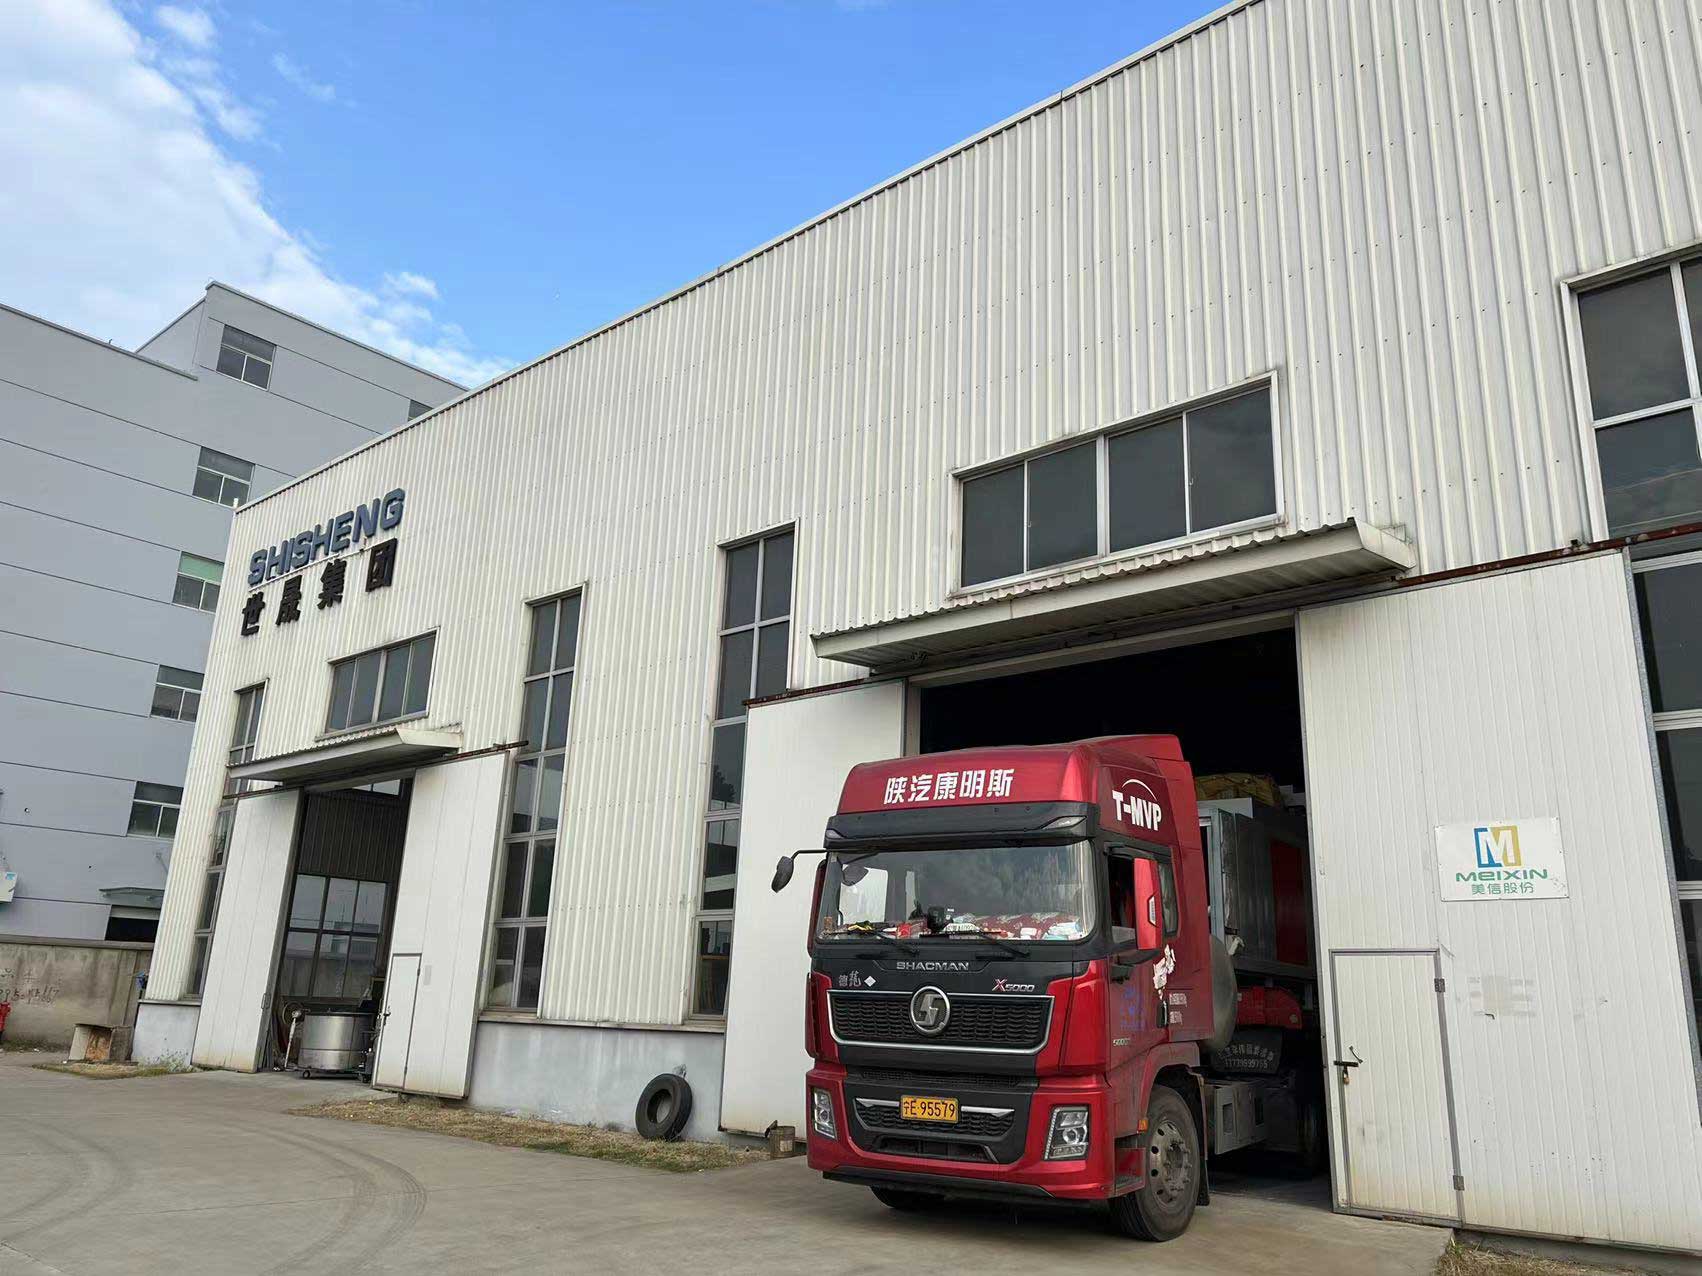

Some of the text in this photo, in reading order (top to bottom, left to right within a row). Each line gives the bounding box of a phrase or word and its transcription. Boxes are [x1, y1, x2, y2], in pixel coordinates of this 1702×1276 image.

[248, 488, 405, 585] SHISHENG
[883, 769, 1014, 804] 陕汽康明斯
[1112, 790, 1162, 831] T-MVP
[1471, 882, 1534, 895] 美信股份
[896, 961, 969, 971] SHACMAN
[992, 978, 1035, 992] X5000
